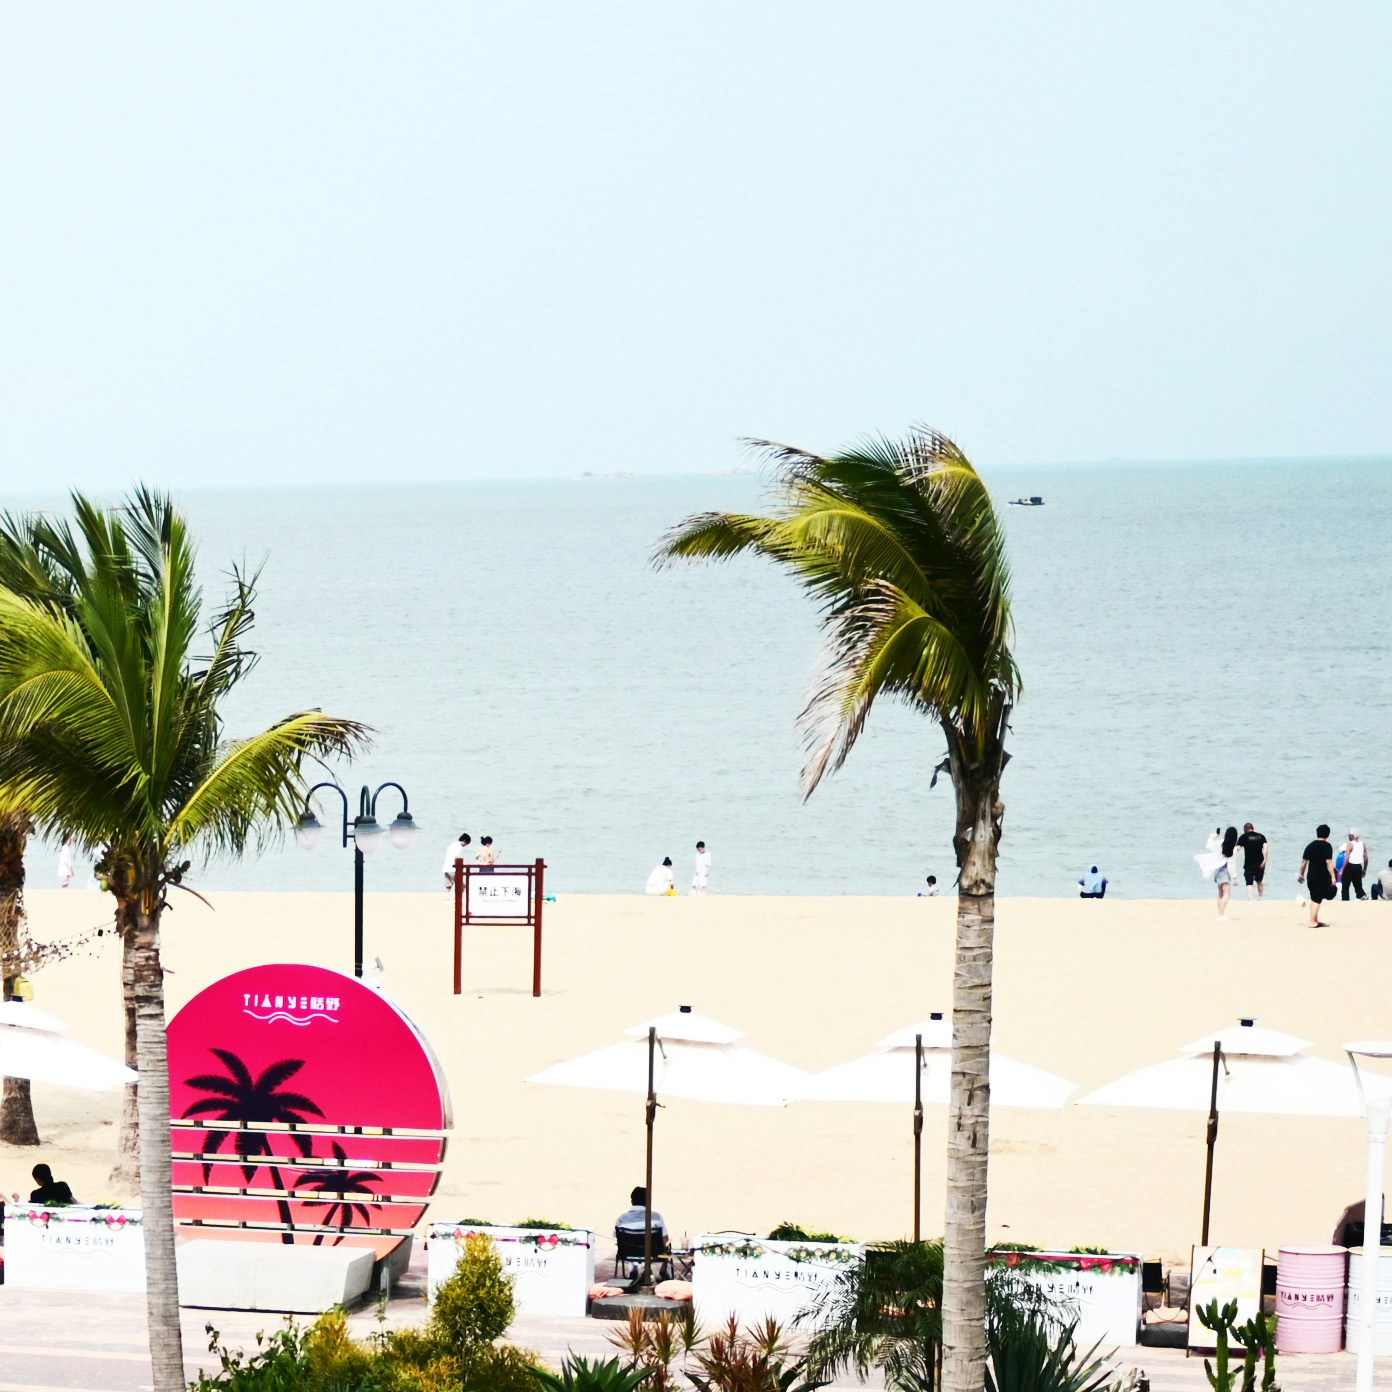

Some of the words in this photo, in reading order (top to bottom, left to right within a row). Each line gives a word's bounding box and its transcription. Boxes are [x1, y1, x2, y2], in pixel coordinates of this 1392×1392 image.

[478, 886, 522, 897] 禁止下海
[243, 993, 308, 1010] TIANYE
